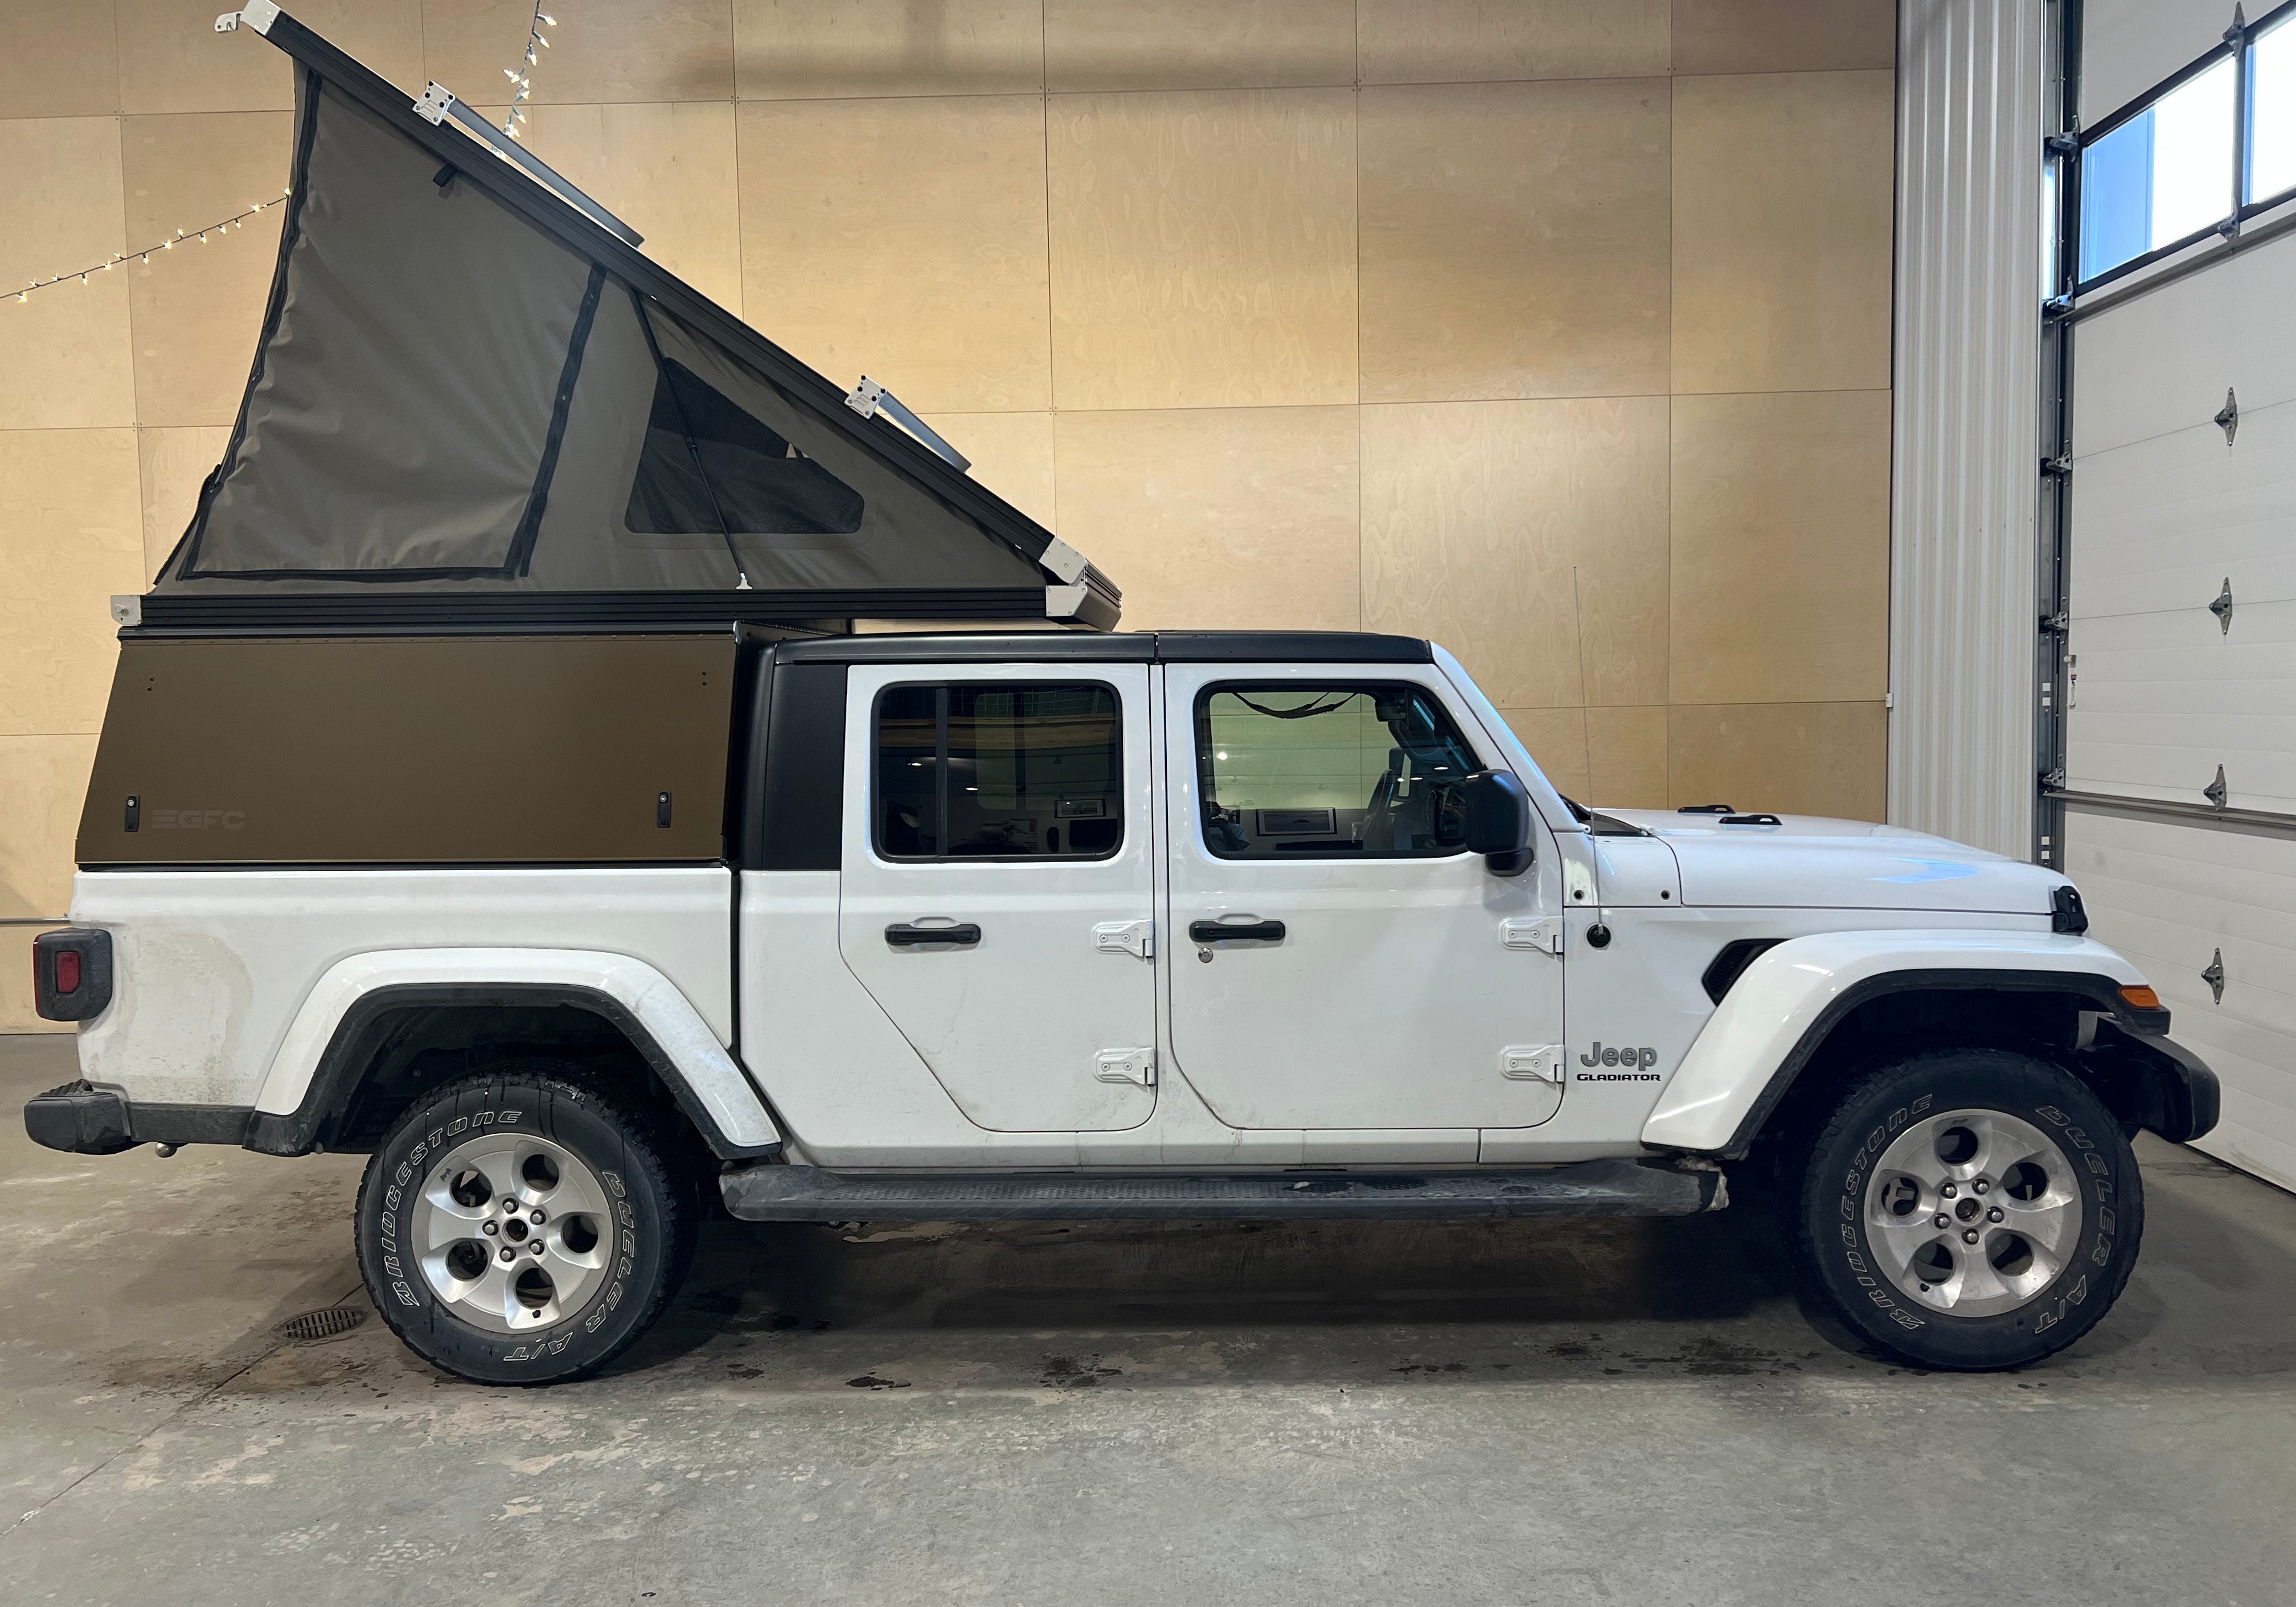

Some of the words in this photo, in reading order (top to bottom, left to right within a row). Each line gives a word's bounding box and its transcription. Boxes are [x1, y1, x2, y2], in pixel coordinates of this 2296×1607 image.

[1580, 1042, 1657, 1071] Jeep
[382, 1110, 522, 1306] BRIDGESTONE
[585, 1171, 636, 1333] DUELER
[1841, 1093, 1933, 1330] BRIDGESTONE
[2035, 1105, 2115, 1266] DUELER
[503, 1331, 573, 1361] A/T
[2035, 1274, 2088, 1334] A/T
